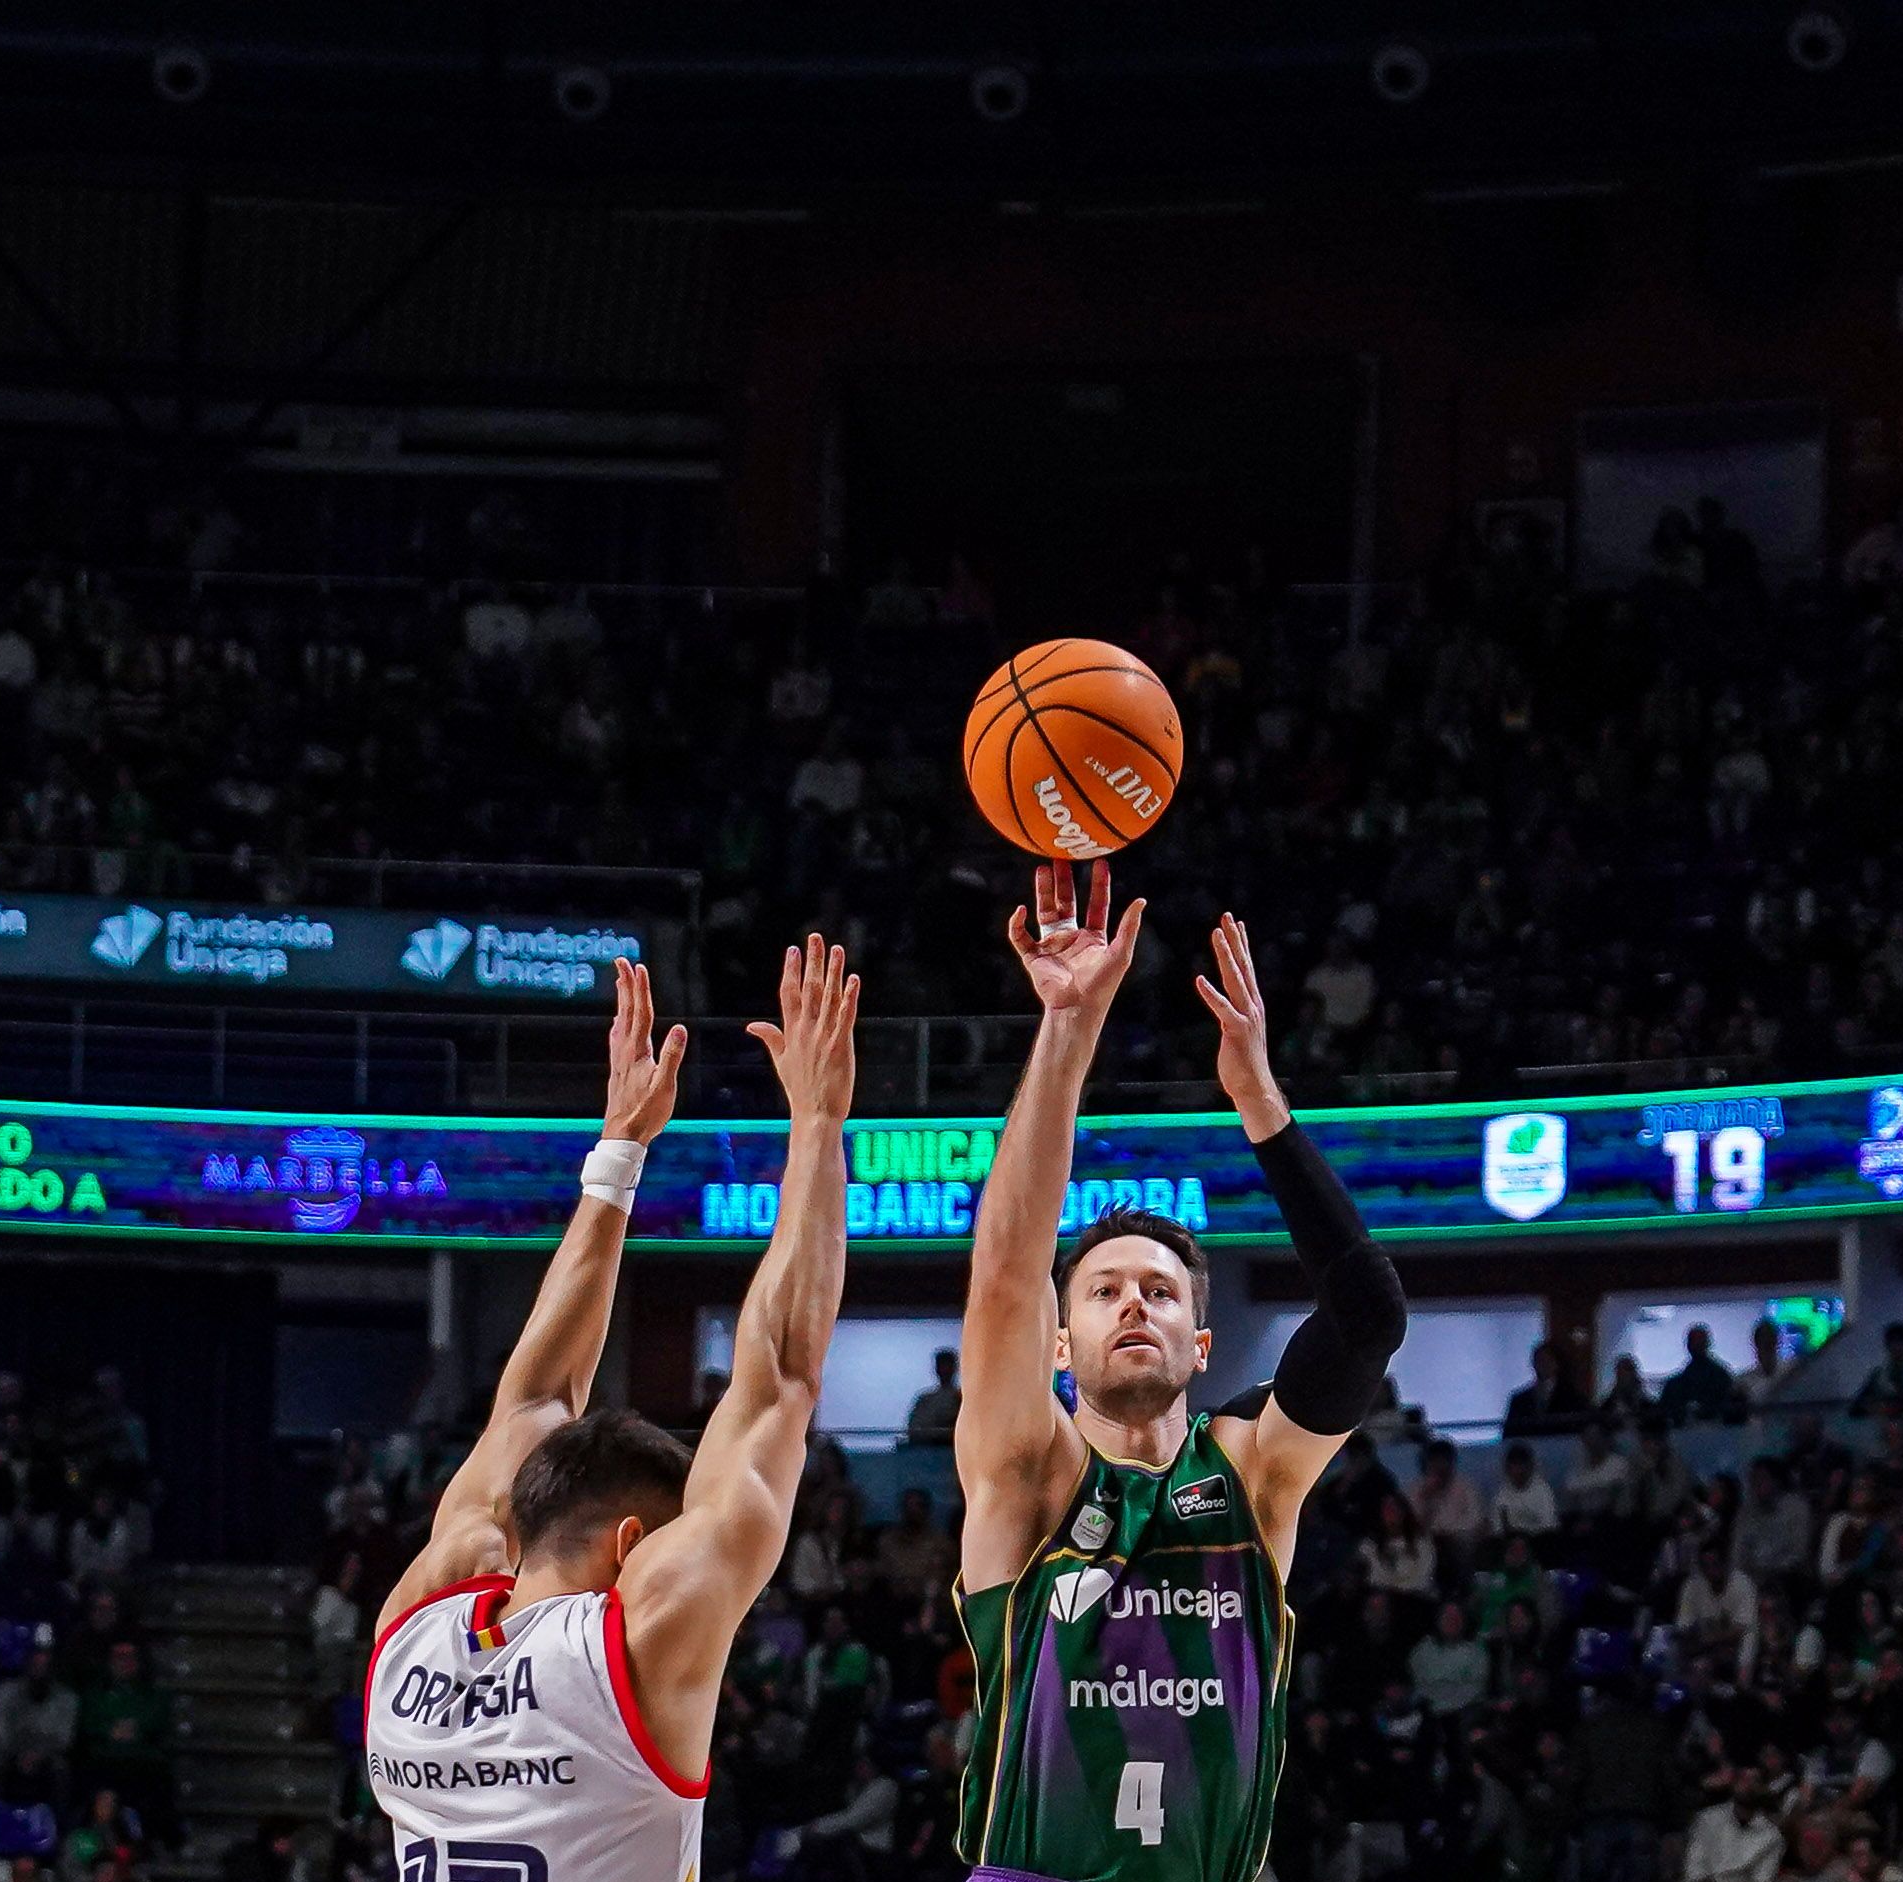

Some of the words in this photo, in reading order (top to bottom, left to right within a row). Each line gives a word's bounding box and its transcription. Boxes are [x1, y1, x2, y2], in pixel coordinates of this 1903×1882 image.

[166, 937, 289, 984] Unicaja
[475, 949, 596, 998] Unicaja
[69, 1171, 108, 1214] A
[201, 1151, 449, 1197] MARBELLA
[1662, 1126, 1767, 1213] 19
[702, 1181, 973, 1238] MOBANC
[1107, 1580, 1244, 1628] Unicaja
[1115, 1761, 1165, 1846] 4
